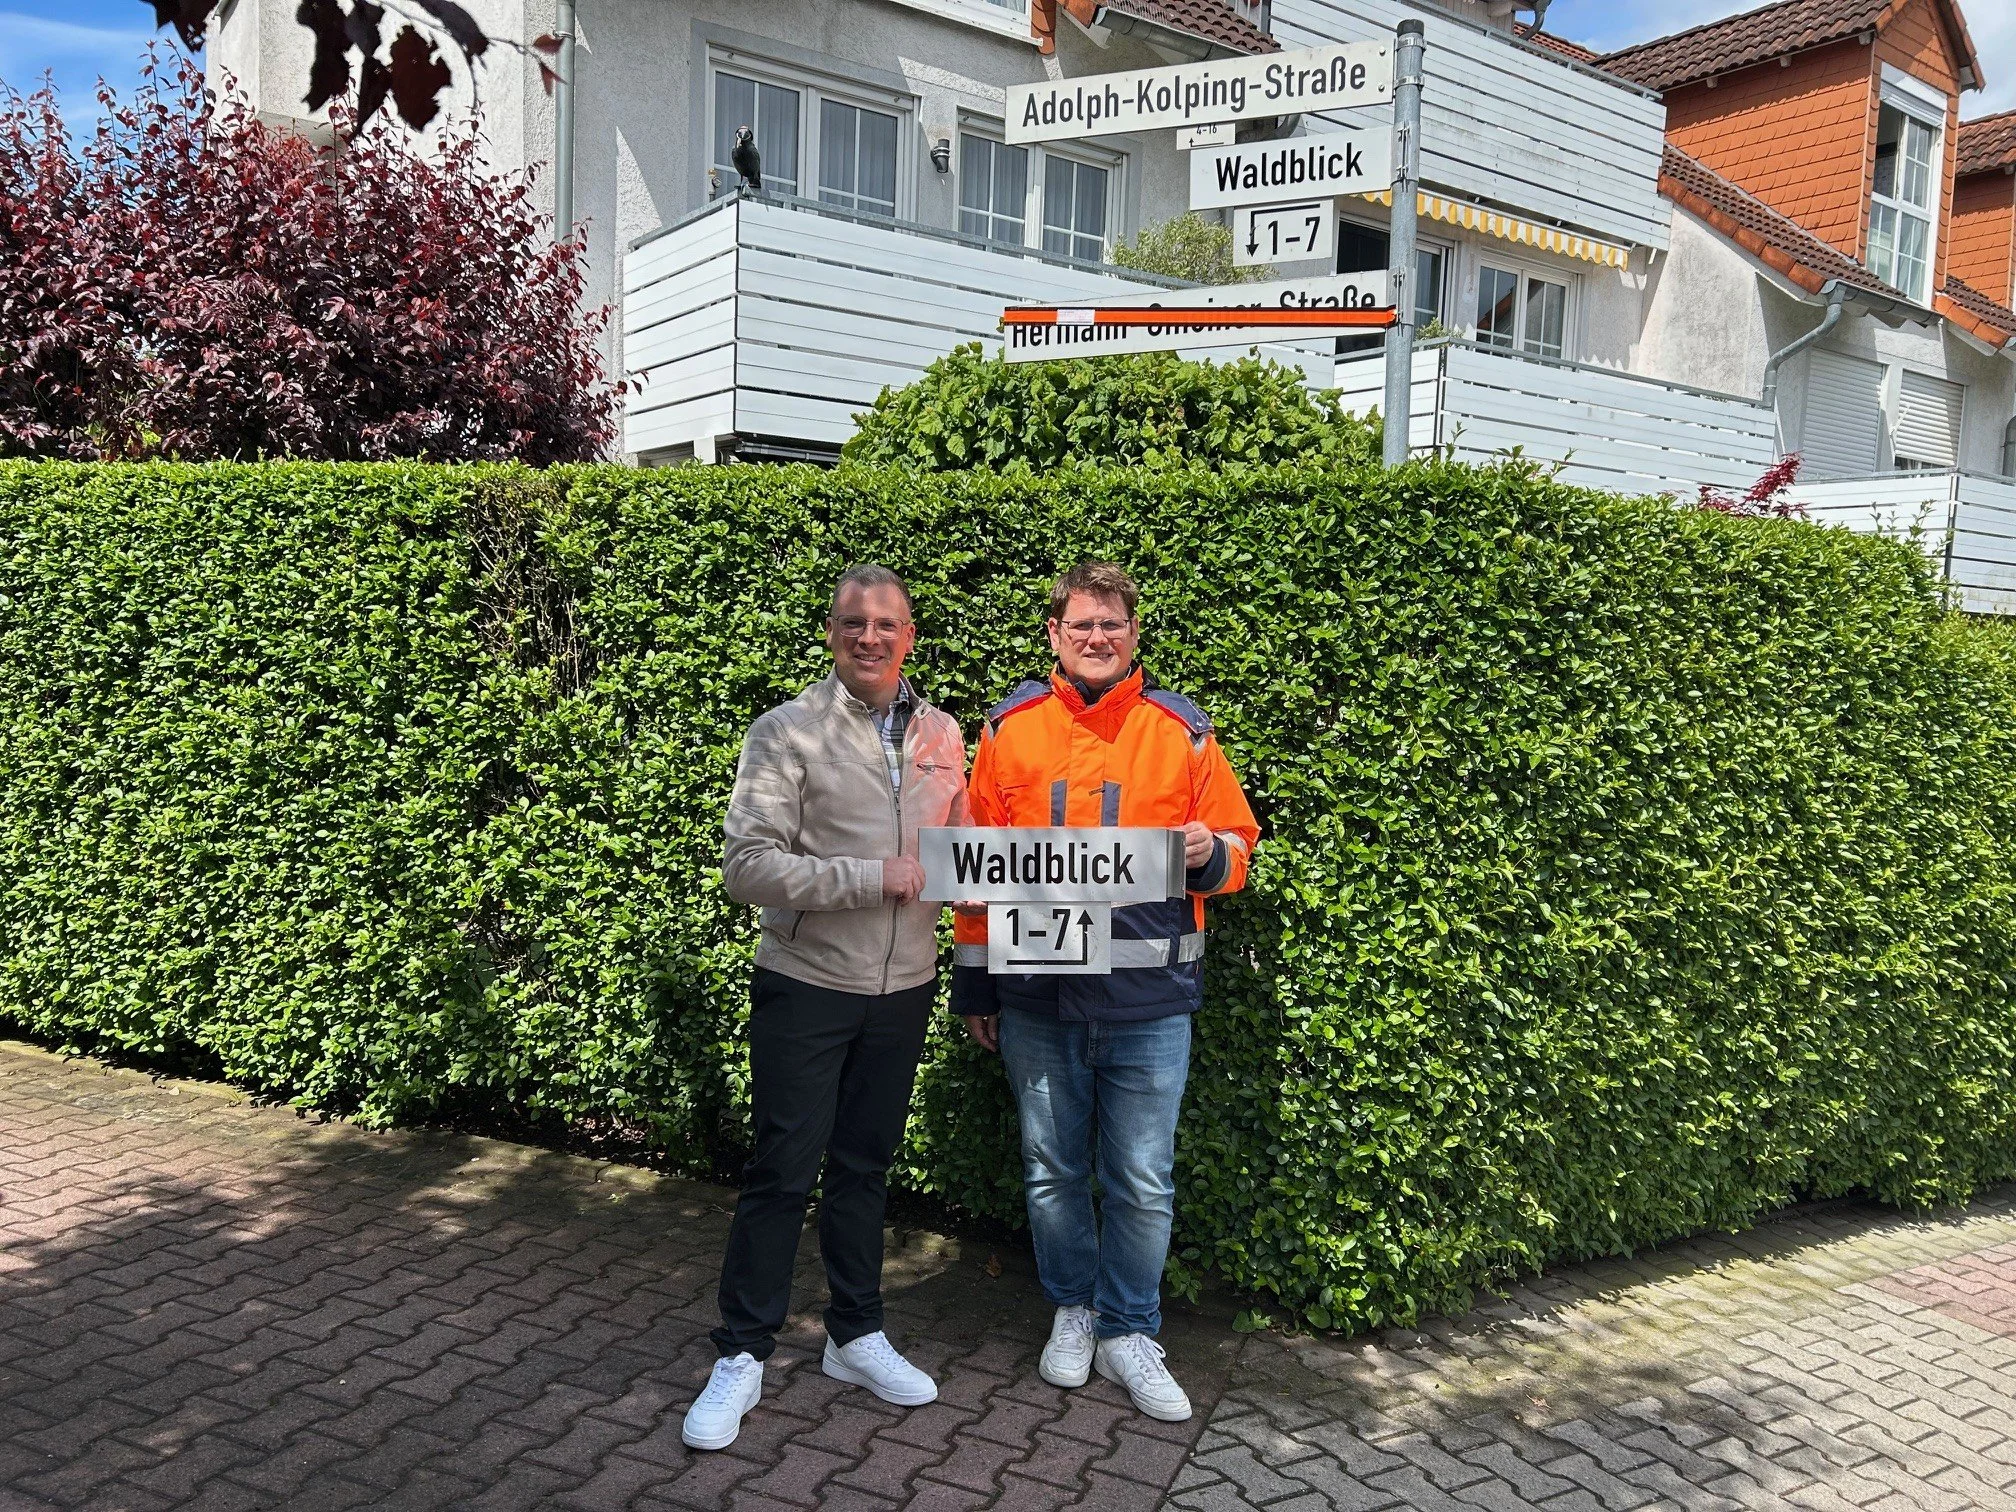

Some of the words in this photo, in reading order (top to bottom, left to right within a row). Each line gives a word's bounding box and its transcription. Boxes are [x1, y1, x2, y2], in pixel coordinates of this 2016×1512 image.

[1022, 55, 1366, 128] Adolph-Kolping-Straße
[1215, 142, 1364, 192] Waldblick
[1267, 216, 1321, 256] 1-7
[952, 842, 1135, 885] Waldblick
[1006, 908, 1071, 950] 1-7
